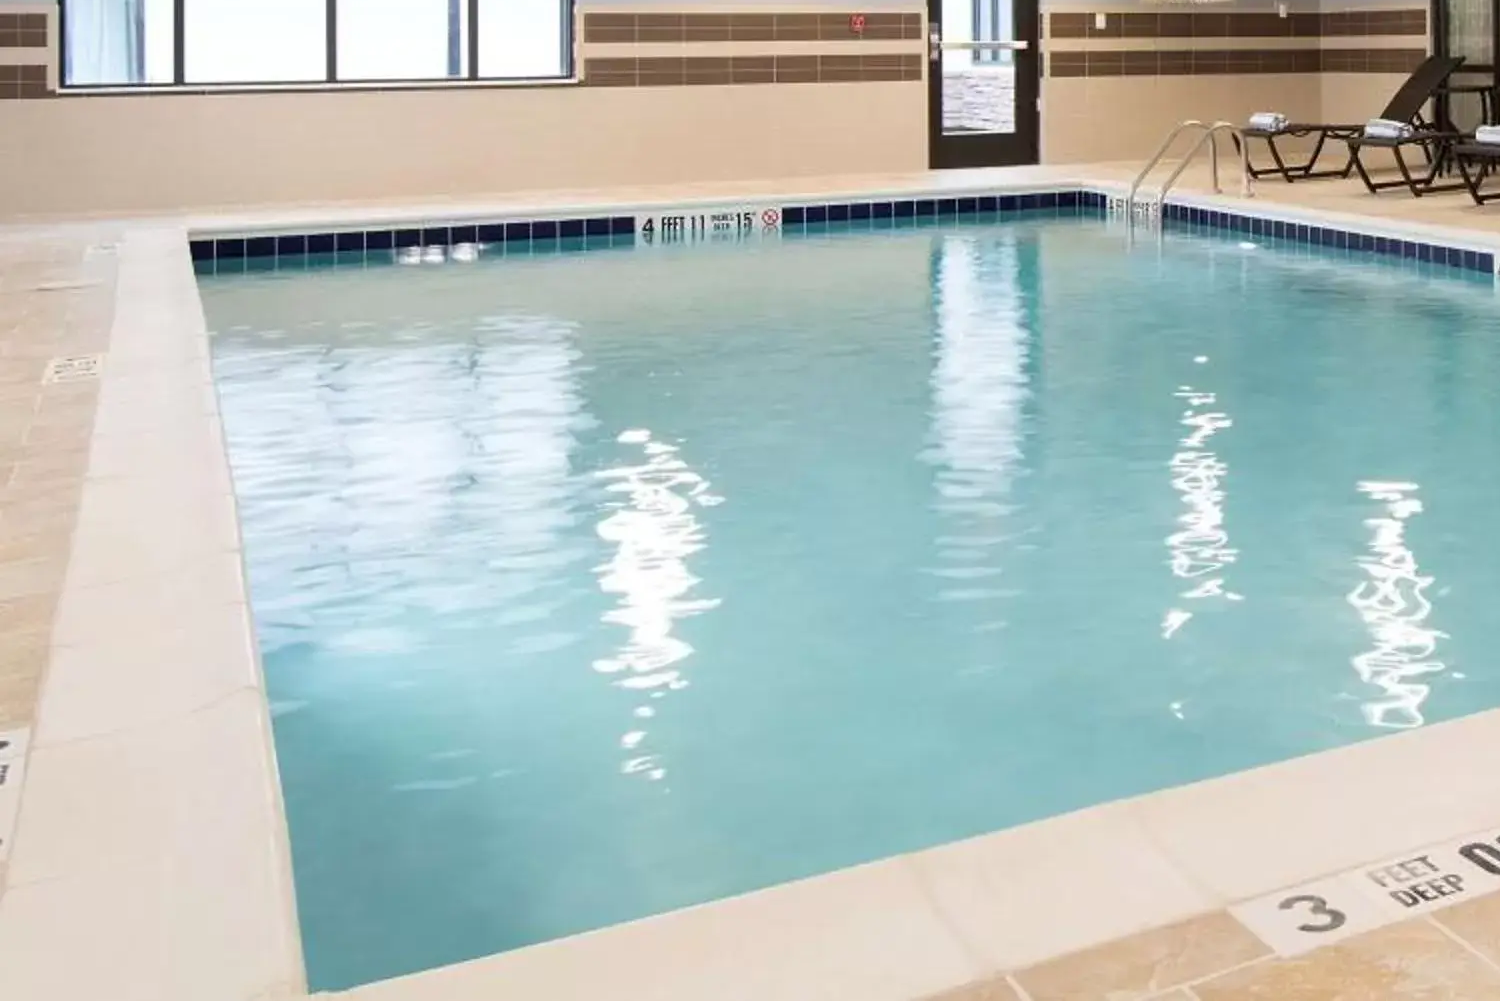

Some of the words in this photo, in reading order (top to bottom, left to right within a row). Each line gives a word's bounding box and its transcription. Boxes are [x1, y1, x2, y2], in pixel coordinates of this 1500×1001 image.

[642, 217, 655, 232] 4
[1365, 854, 1440, 888] FEET
[1388, 874, 1465, 909] DEEP
[1277, 894, 1347, 934] 3
